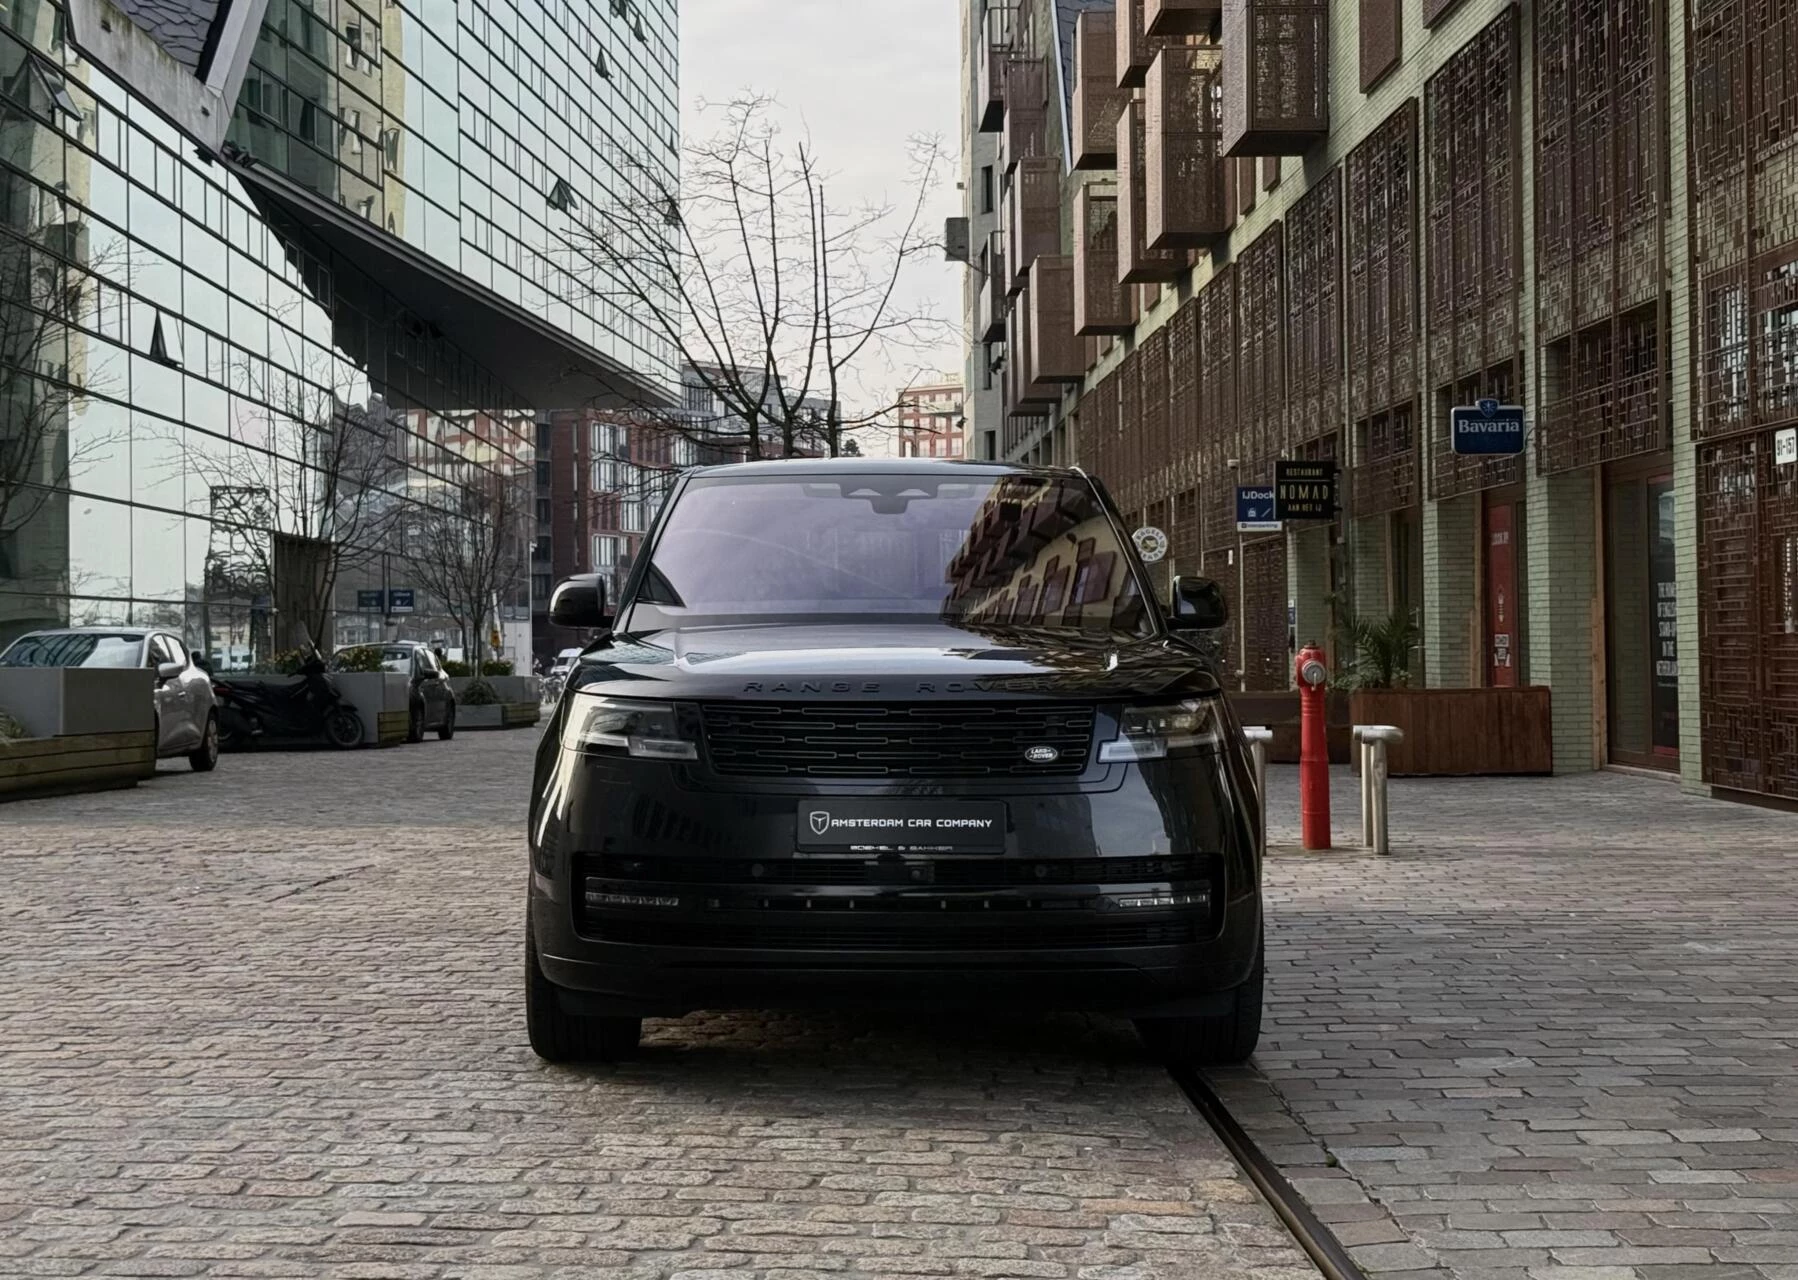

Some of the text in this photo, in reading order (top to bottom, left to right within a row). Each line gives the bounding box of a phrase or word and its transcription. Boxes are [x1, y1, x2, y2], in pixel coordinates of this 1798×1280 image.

[1458, 418, 1520, 434] Bavaria
[1286, 467, 1323, 476] RESTAURANT
[1280, 484, 1329, 500] NOMAD
[743, 680, 1052, 694] RANGE ROVER
[831, 818, 993, 828] AMSTERDAM CAR COMPANY
